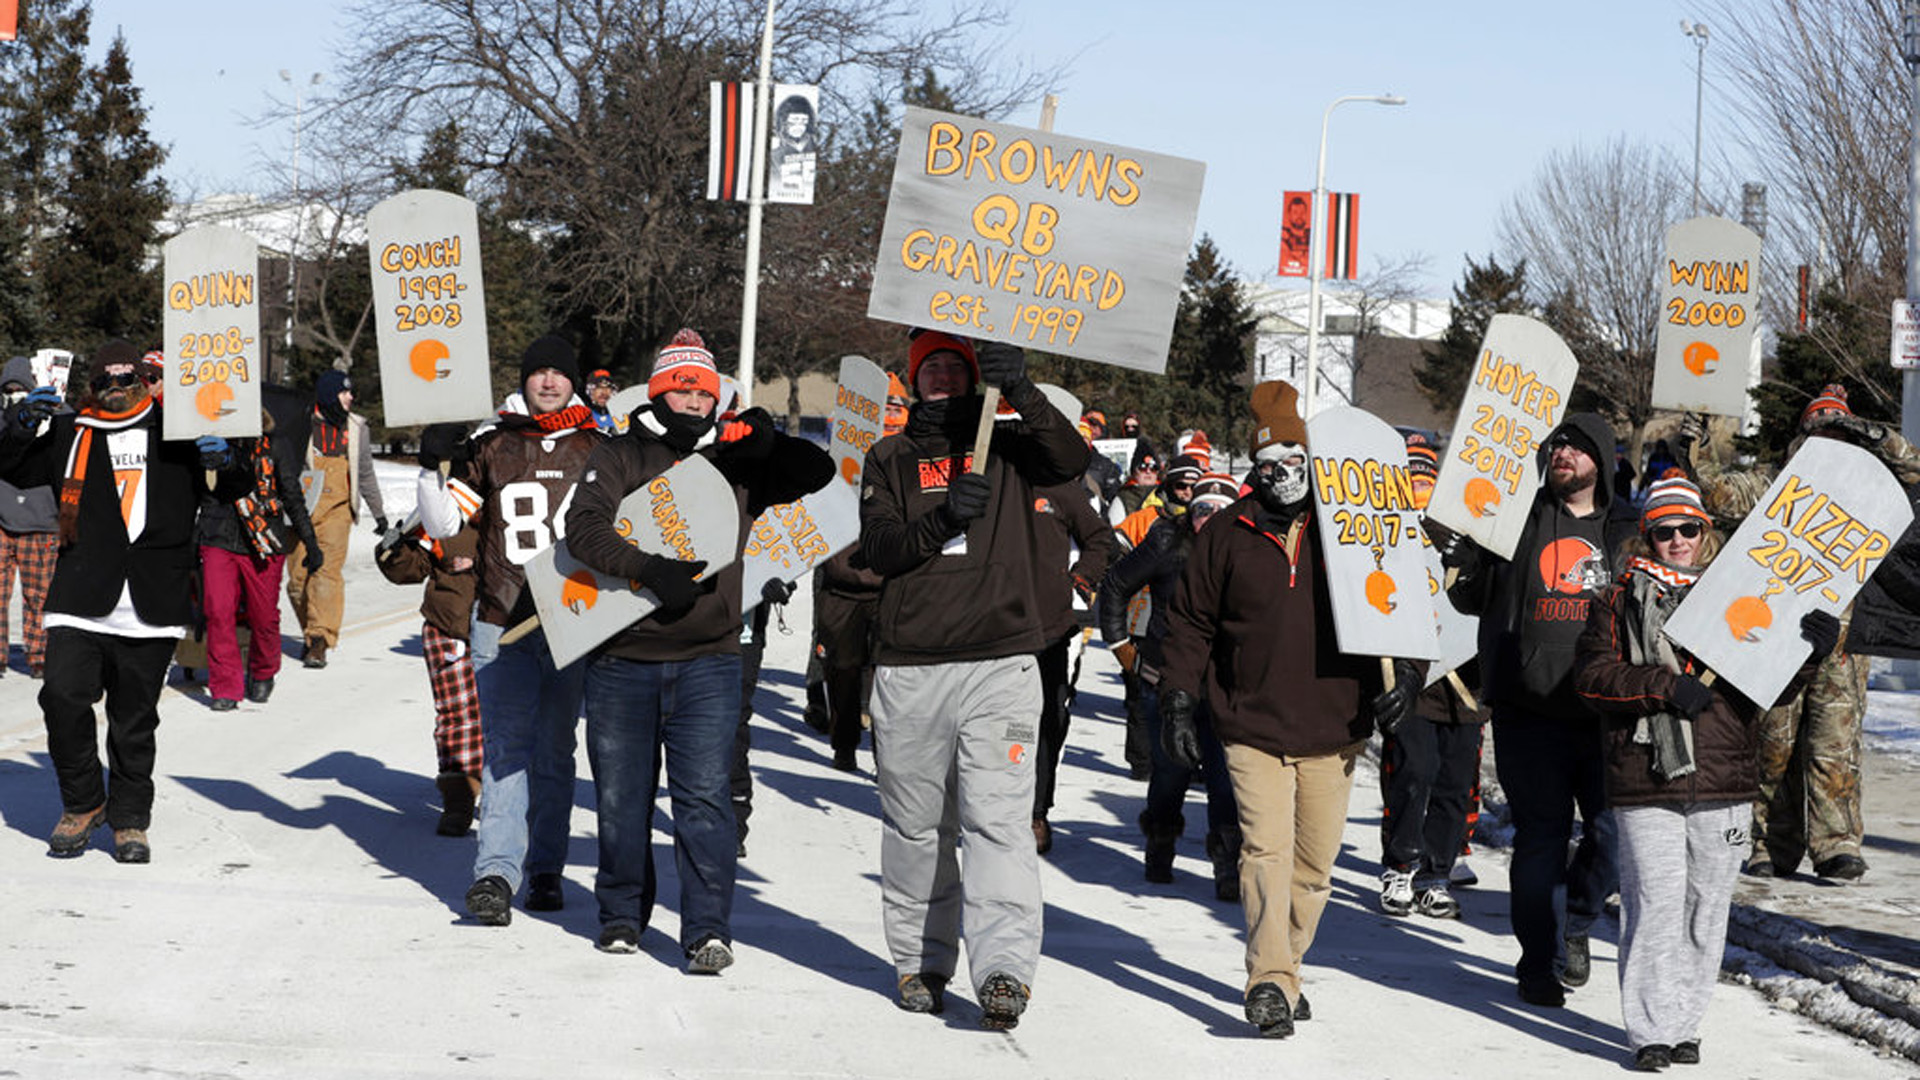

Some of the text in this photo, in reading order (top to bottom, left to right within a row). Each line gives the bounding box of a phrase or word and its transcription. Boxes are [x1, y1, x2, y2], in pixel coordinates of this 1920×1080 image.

[926, 122, 1143, 206] BROWNS
[972, 194, 1059, 256] QB
[381, 235, 460, 273] COUCH
[901, 229, 1125, 310] GRAVEYARD
[169, 271, 253, 312] QUINN
[400, 273, 467, 300] 1999-
[1669, 260, 1748, 294] WYNN
[396, 303, 462, 332] 2003
[929, 291, 1084, 346] est. 1999
[1667, 297, 1745, 328] 2000
[180, 326, 254, 358] 2008-
[180, 356, 248, 386] 2009
[1477, 350, 1561, 427] HOYER
[837, 384, 879, 425] DILFER
[837, 420, 875, 454] 2005
[1472, 406, 1541, 459] 2013-
[1314, 457, 1417, 510] HOGAN
[1459, 437, 1523, 495] 2014
[1334, 511, 1417, 547] 2017-
[1766, 475, 1891, 583] KIZER
[1748, 531, 1840, 603] 2017-
[1761, 578, 1785, 601] ?
